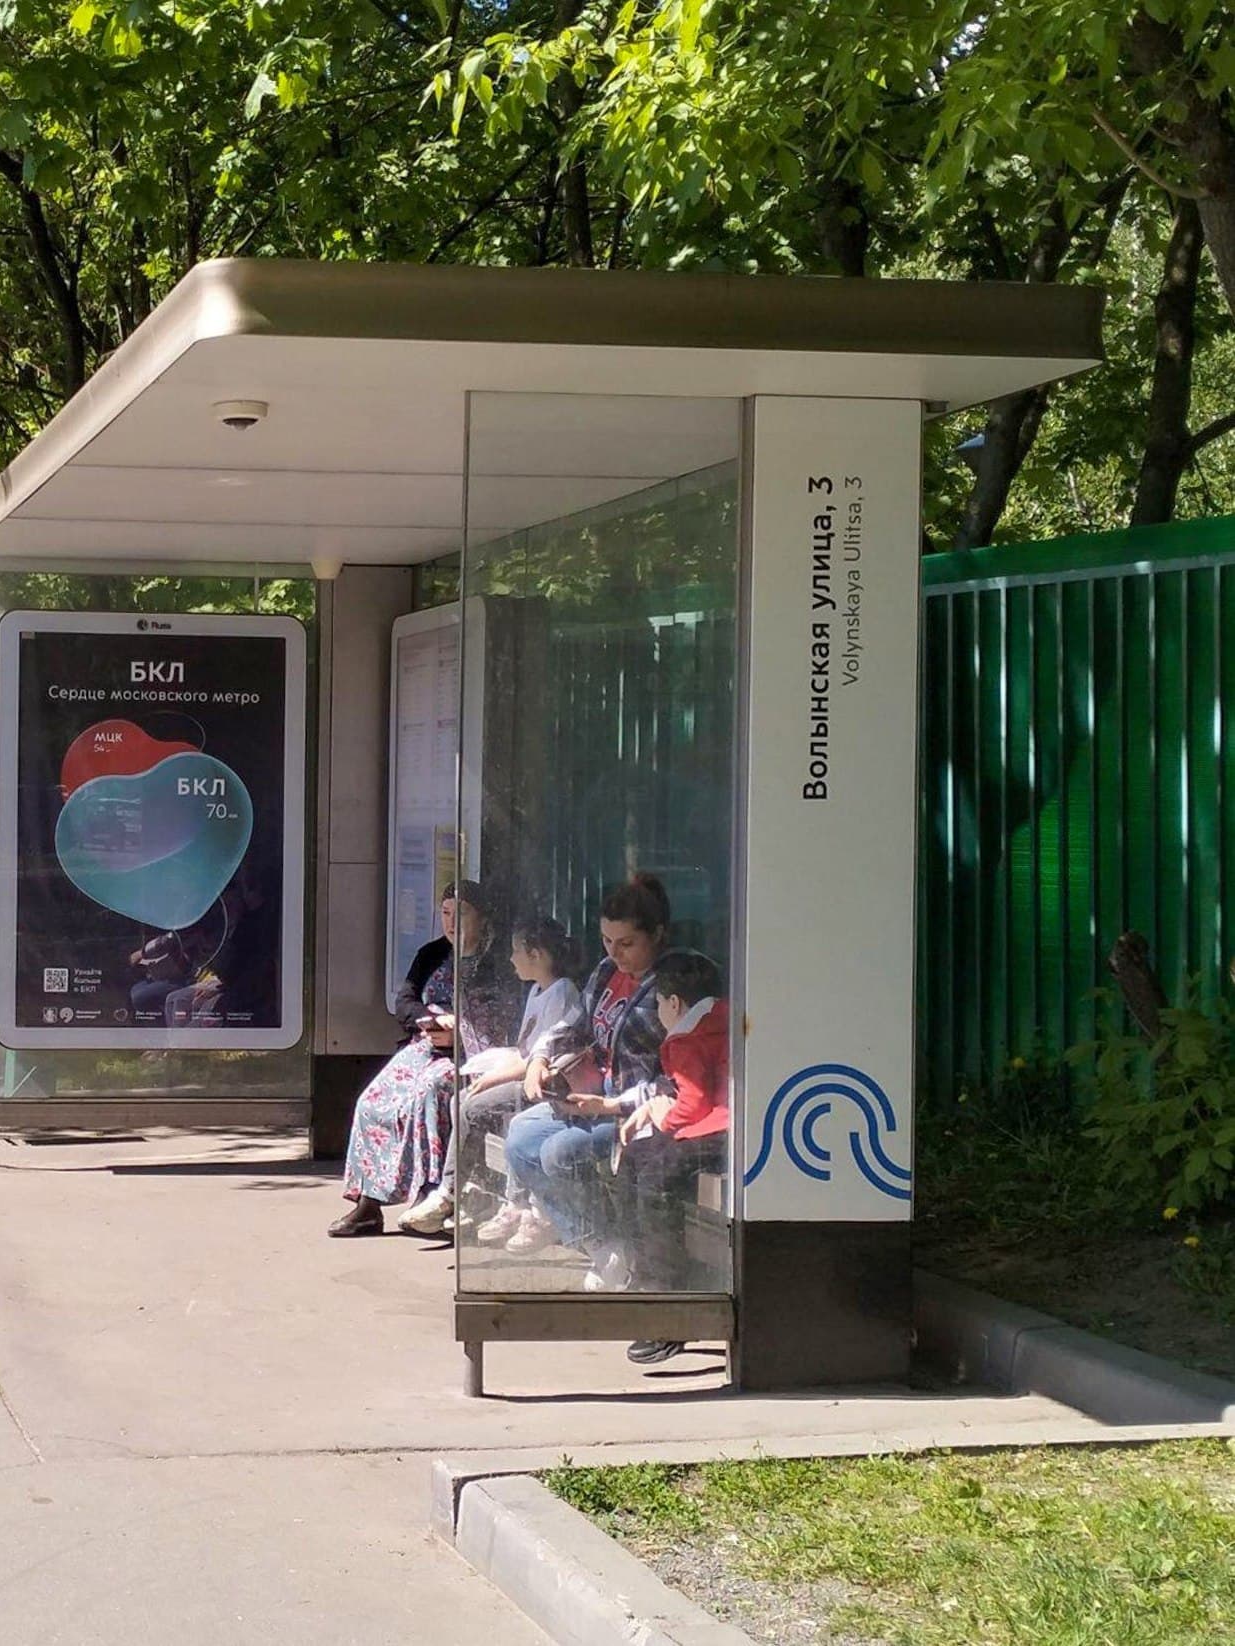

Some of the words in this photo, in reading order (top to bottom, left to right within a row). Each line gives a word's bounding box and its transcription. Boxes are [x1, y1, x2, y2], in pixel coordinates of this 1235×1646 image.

[808, 476, 833, 495] 3
[845, 476, 862, 489] 3
[843, 497, 865, 562] Ulitsa,
[812, 505, 837, 610] улица,
[841, 569, 864, 686] Volynskaya
[130, 661, 185, 683] БКЛ
[48, 685, 106, 701] Сердце
[110, 690, 208, 702] московского
[212, 692, 260, 705] метро
[803, 622, 830, 800] Волынская
[94, 732, 123, 743] МЦК
[177, 777, 226, 796] БКЛ
[206, 803, 227, 819] 70
